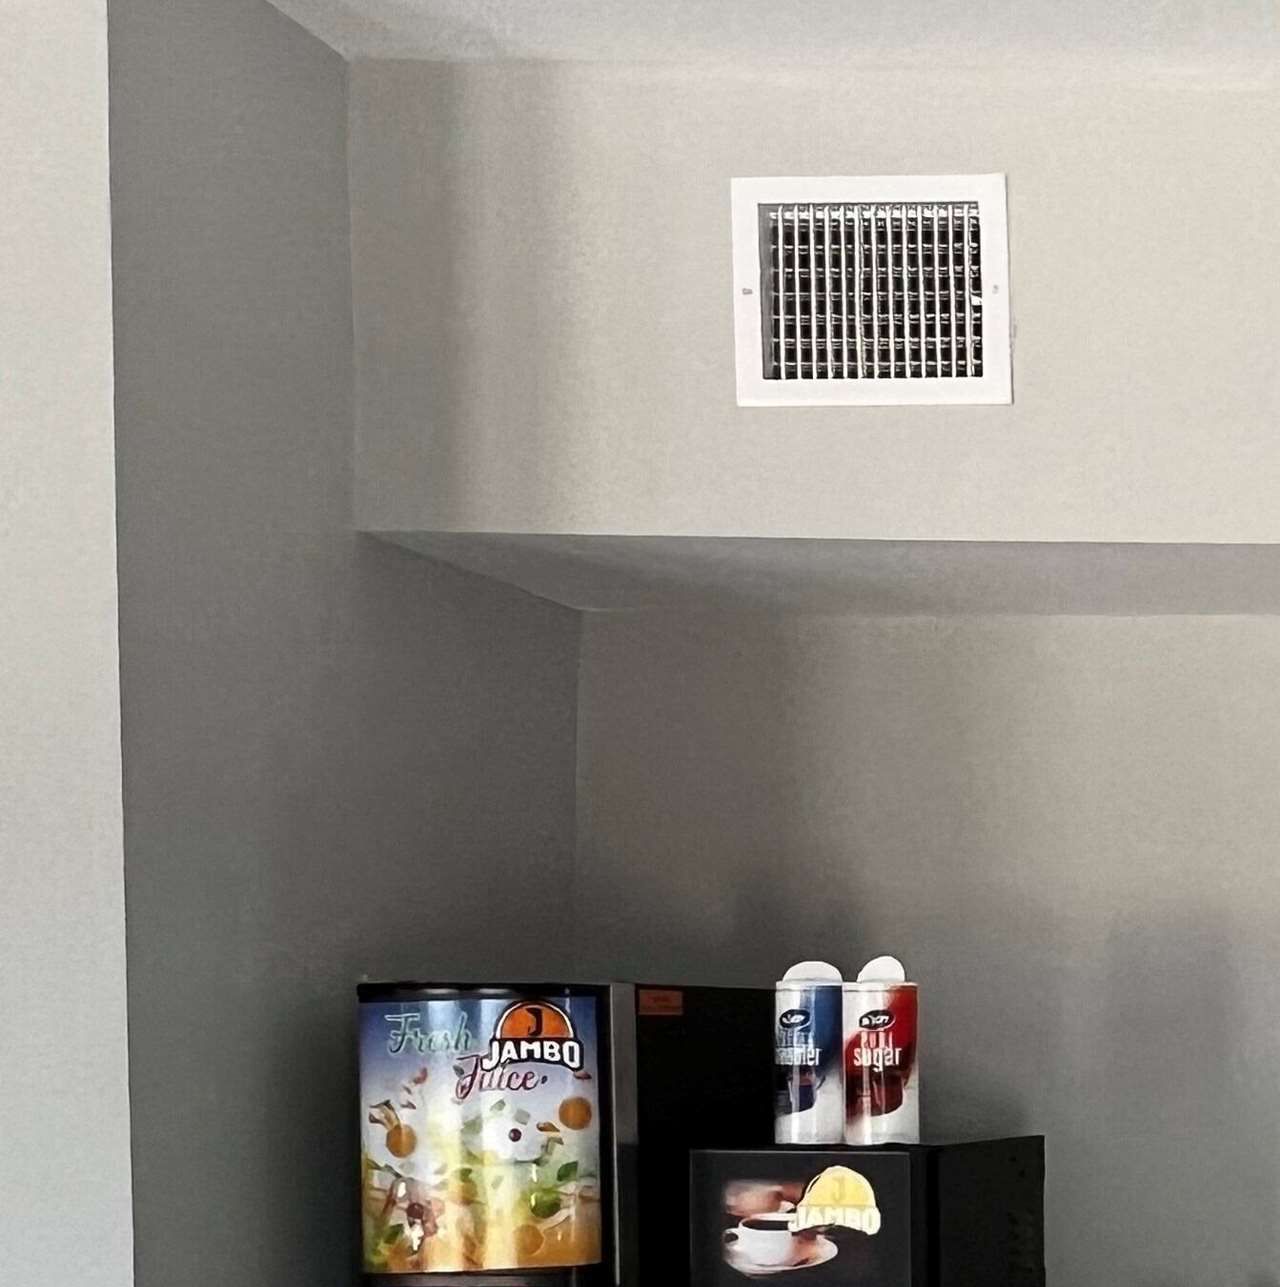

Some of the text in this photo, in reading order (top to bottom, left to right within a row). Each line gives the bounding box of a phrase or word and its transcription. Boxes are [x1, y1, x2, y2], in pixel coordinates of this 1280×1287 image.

[383, 1011, 473, 1055] Fresh
[480, 1039, 582, 1072] JAMBO
[853, 1047, 903, 1072] sugar
[455, 1054, 542, 1100] Juice
